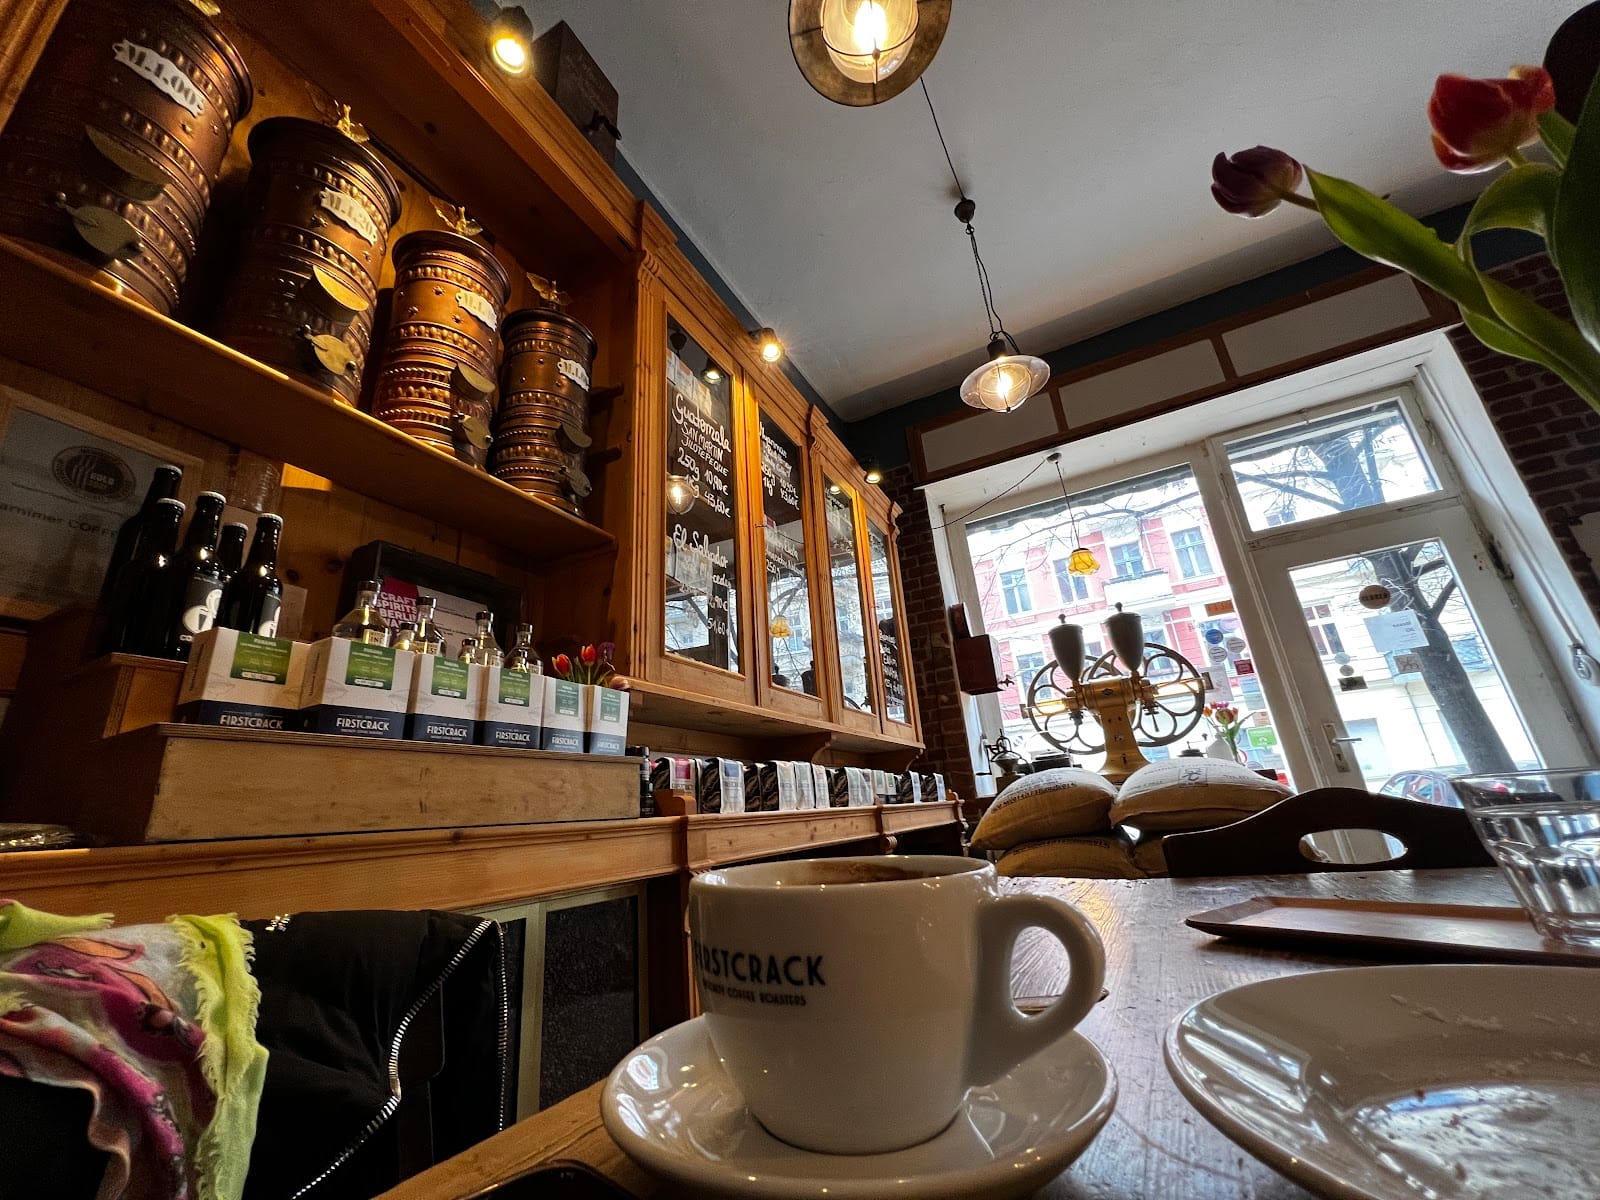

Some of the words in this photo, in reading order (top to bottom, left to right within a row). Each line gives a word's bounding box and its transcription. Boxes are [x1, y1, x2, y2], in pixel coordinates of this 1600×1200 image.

[681, 422, 698, 441] SAN
[699, 435, 723, 462] MARTIN
[681, 434, 729, 476] JILOTEPEQUE
[678, 447, 699, 481] 250g
[673, 524, 687, 551] El
[690, 531, 728, 569] Salvador
[377, 599, 417, 614] SPIRITS
[381, 592, 417, 606] CRAFT
[219, 714, 283, 729] FIRSTCRACK
[336, 717, 390, 731] FIRSTCRACK
[427, 725, 468, 737] FIRSTCRACK
[495, 731, 531, 742] FIRSTCRACK
